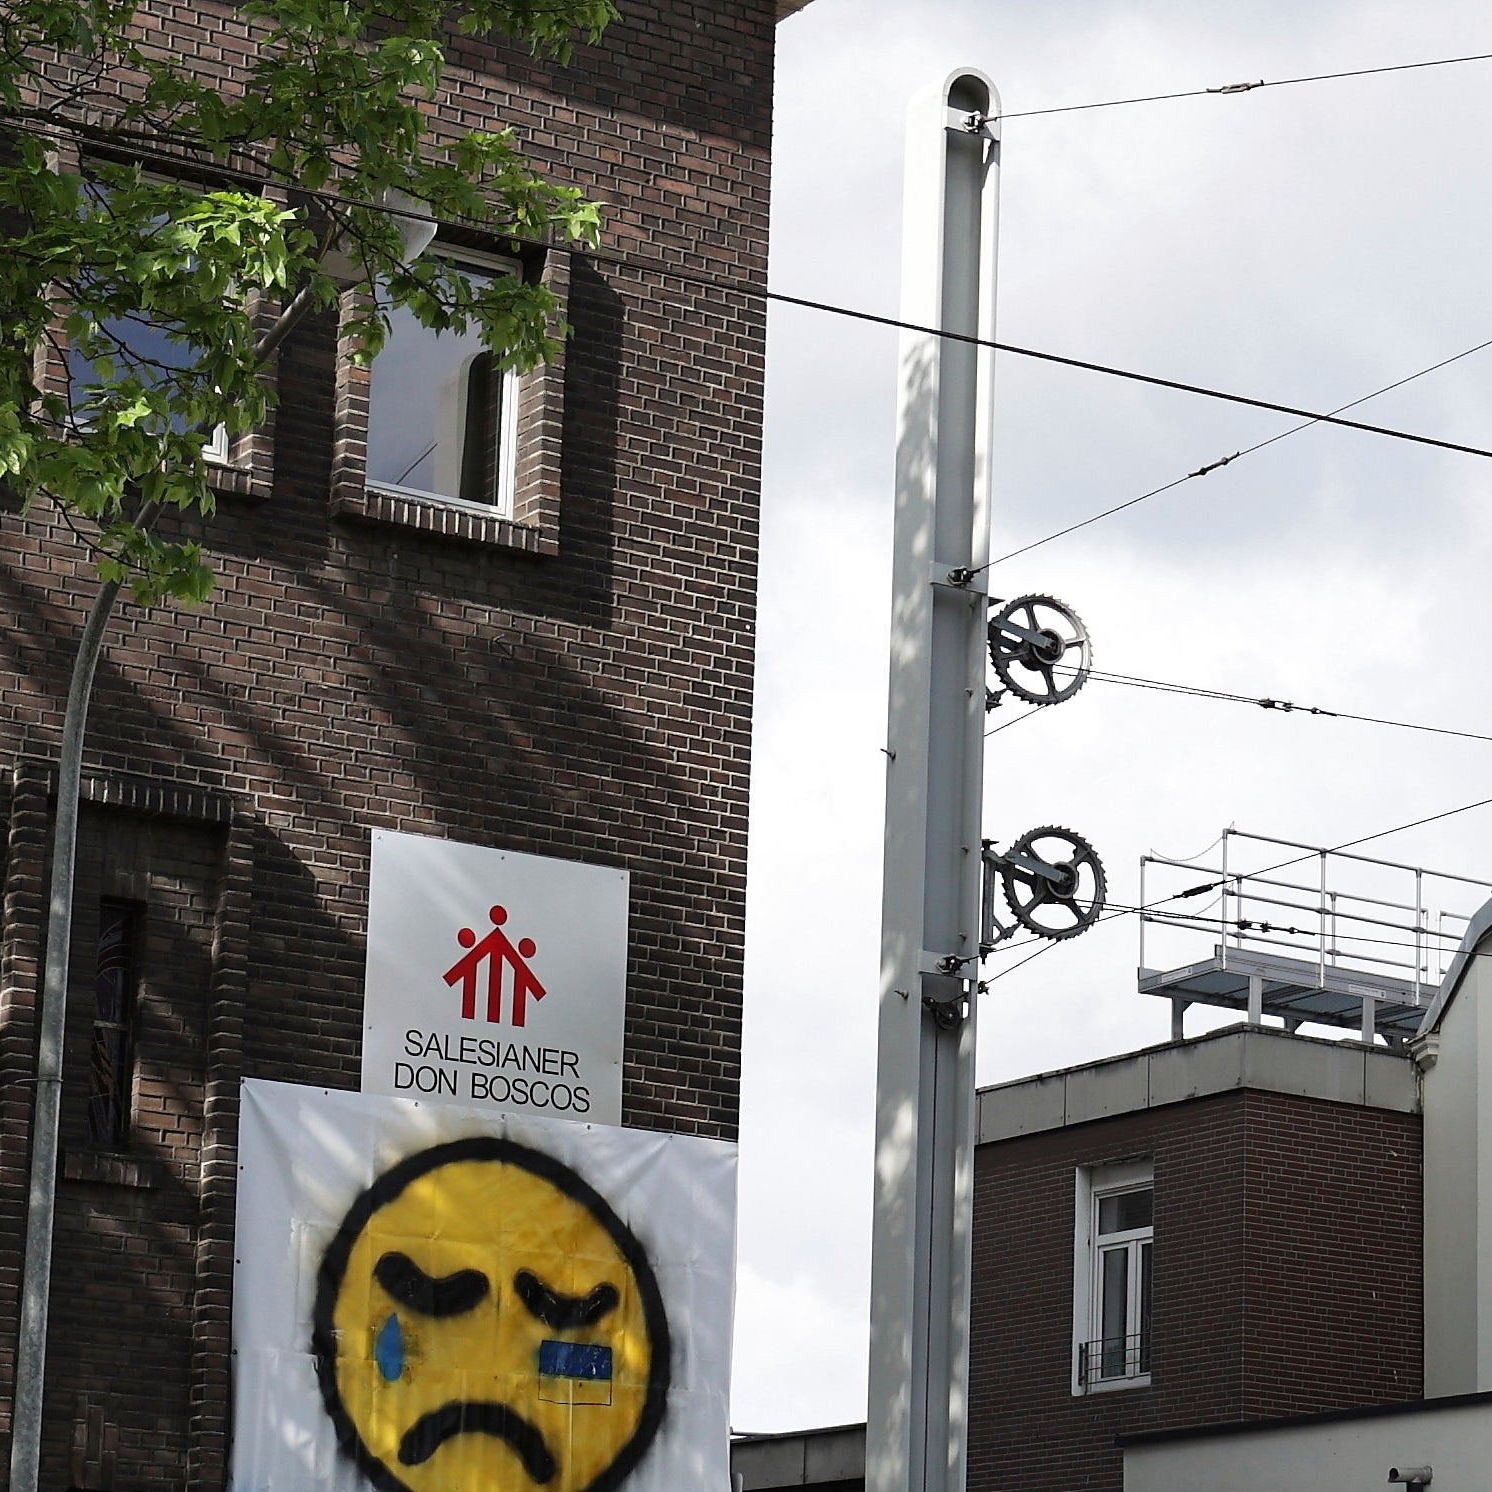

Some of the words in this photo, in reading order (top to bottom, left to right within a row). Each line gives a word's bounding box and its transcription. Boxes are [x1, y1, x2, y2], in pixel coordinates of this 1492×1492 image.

[404, 1029, 581, 1079] SALESIANER
[394, 1062, 458, 1096] DON
[470, 1072, 591, 1113] BOSCOS
